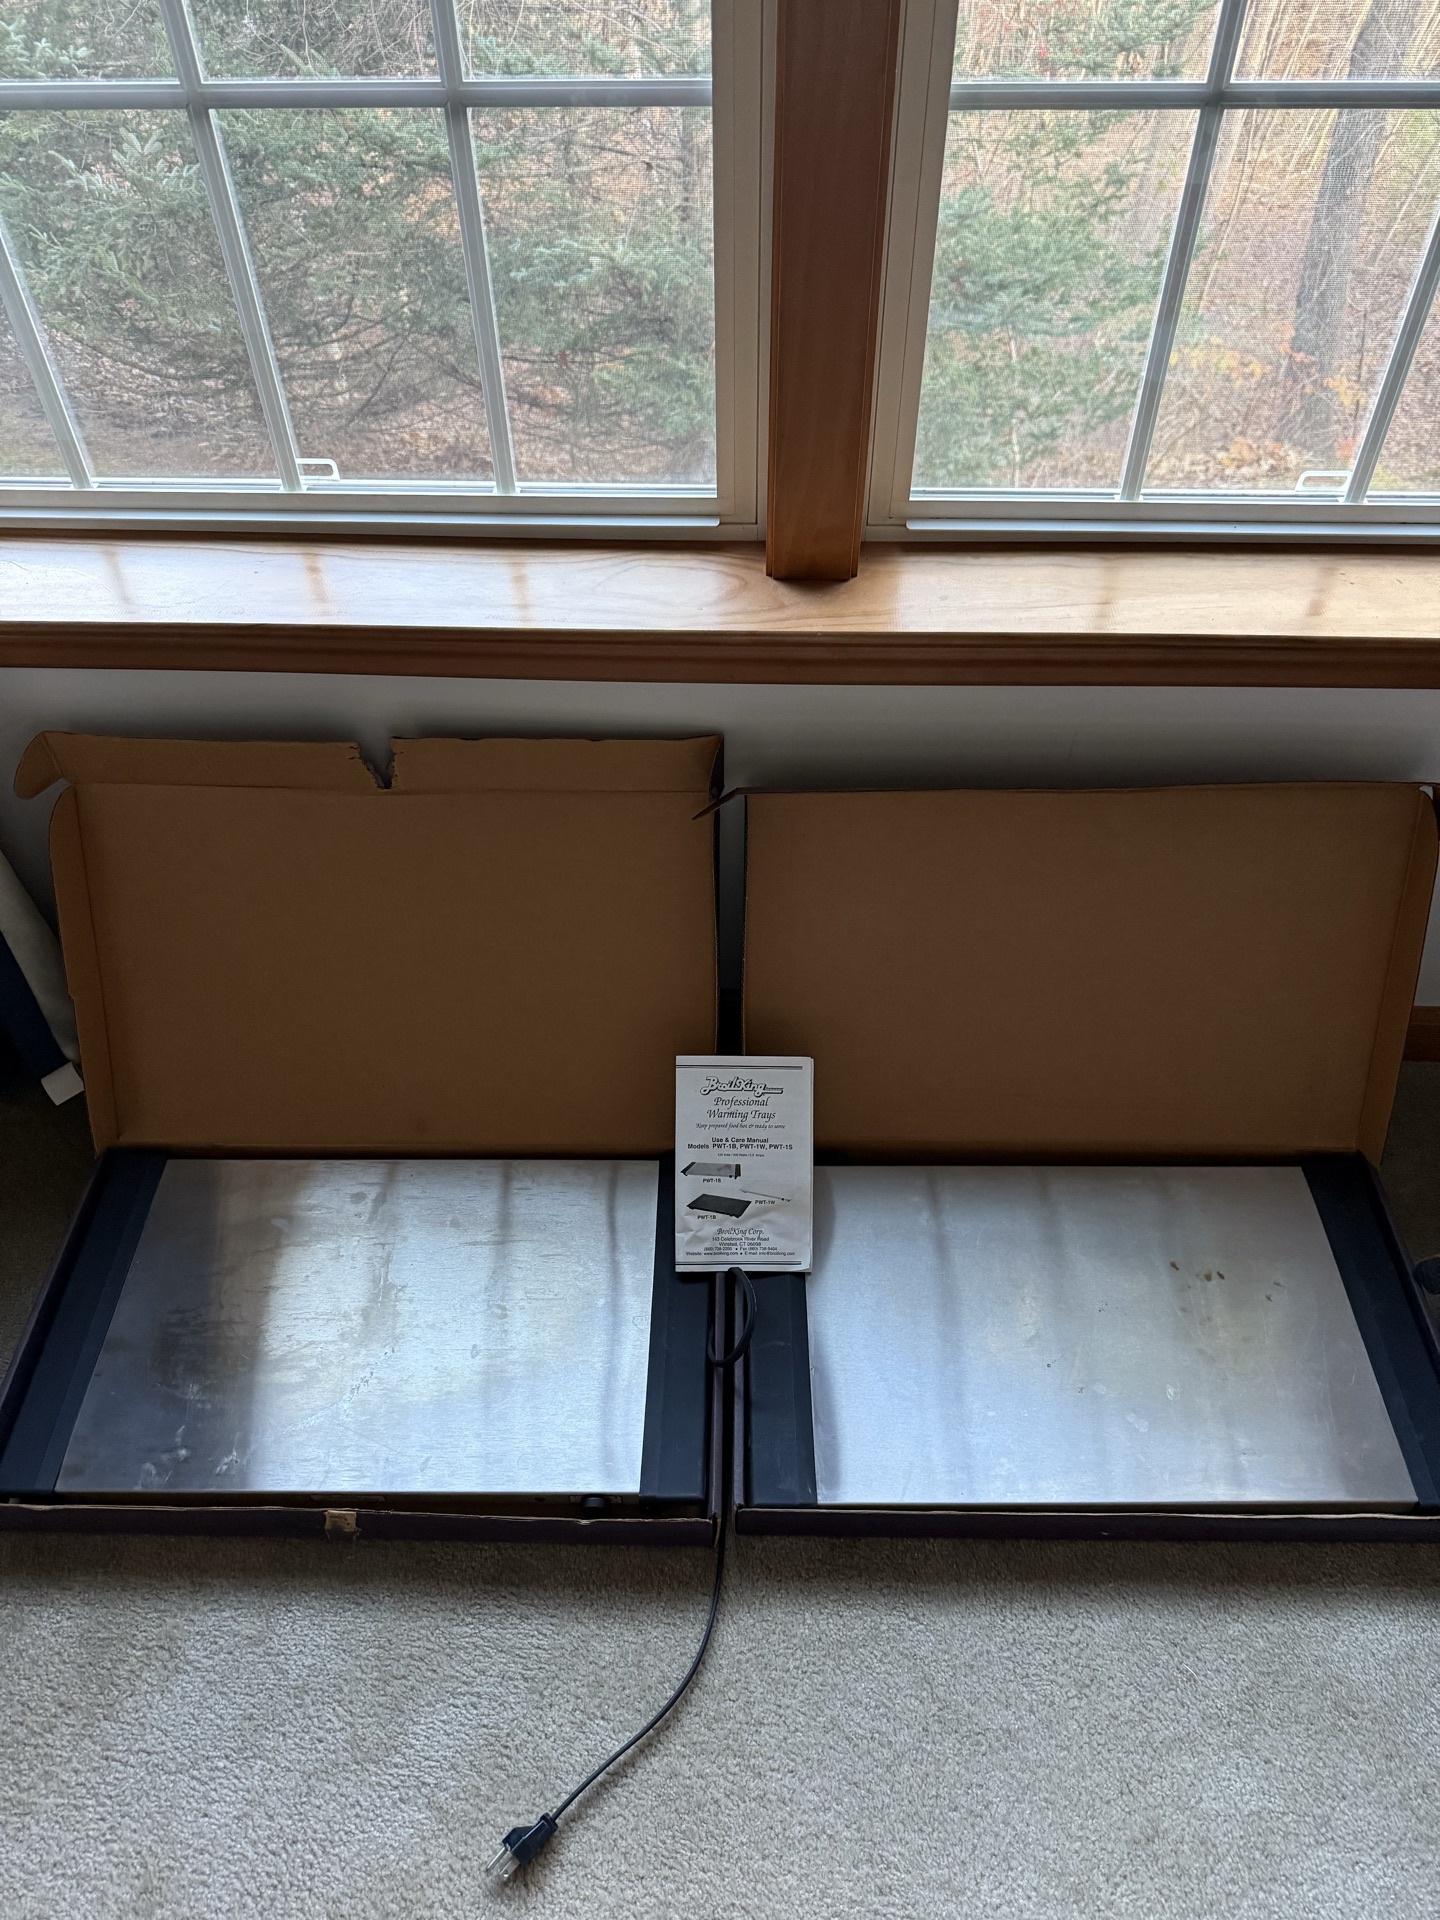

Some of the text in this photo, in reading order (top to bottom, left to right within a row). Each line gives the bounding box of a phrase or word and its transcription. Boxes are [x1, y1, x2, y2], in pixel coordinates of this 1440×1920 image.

[700, 1076, 783, 1098] BroilKing
[714, 1096, 771, 1109] Professional
[707, 1109, 776, 1122] Warming Trays
[727, 1122, 739, 1130] food
[716, 1227, 765, 1237] BroilKing Corp.
